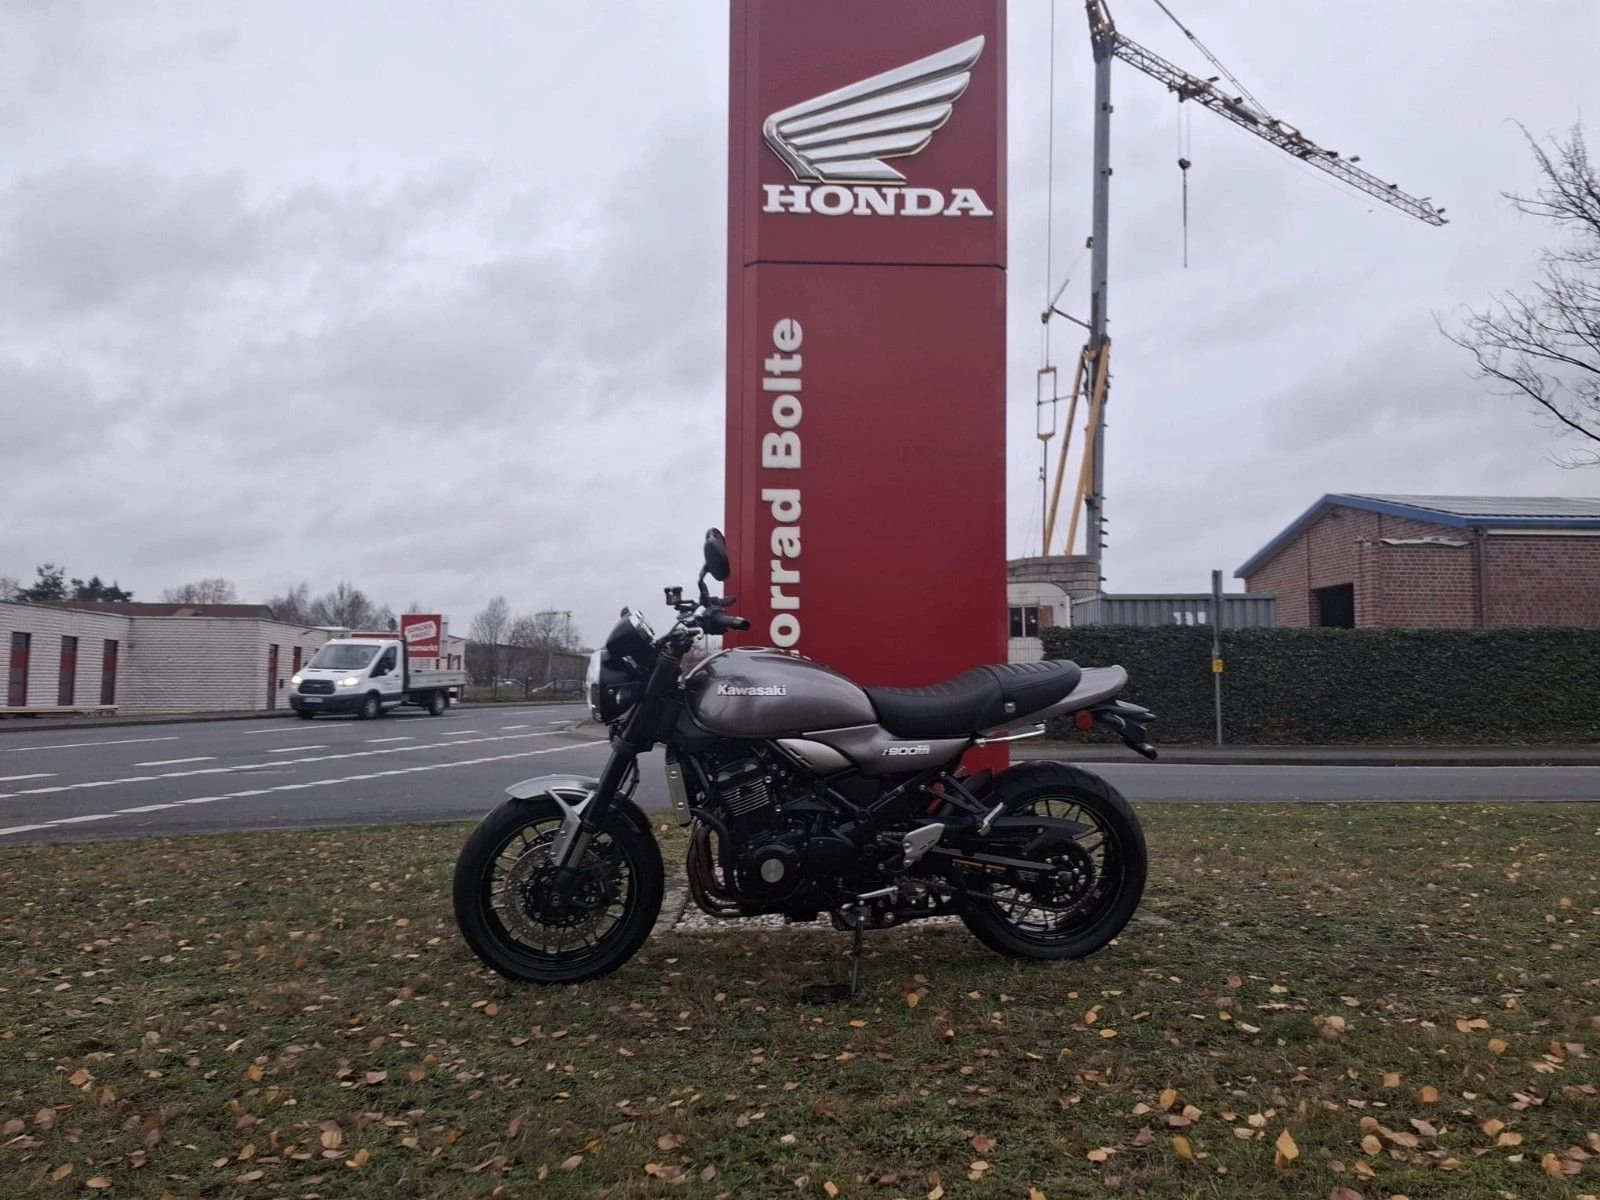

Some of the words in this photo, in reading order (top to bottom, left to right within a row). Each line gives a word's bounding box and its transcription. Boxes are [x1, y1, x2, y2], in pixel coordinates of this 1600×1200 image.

[762, 184, 993, 216] HONDA
[762, 318, 803, 468] Bolte
[762, 489, 801, 653] orrad
[717, 684, 787, 696] Kawasaki
